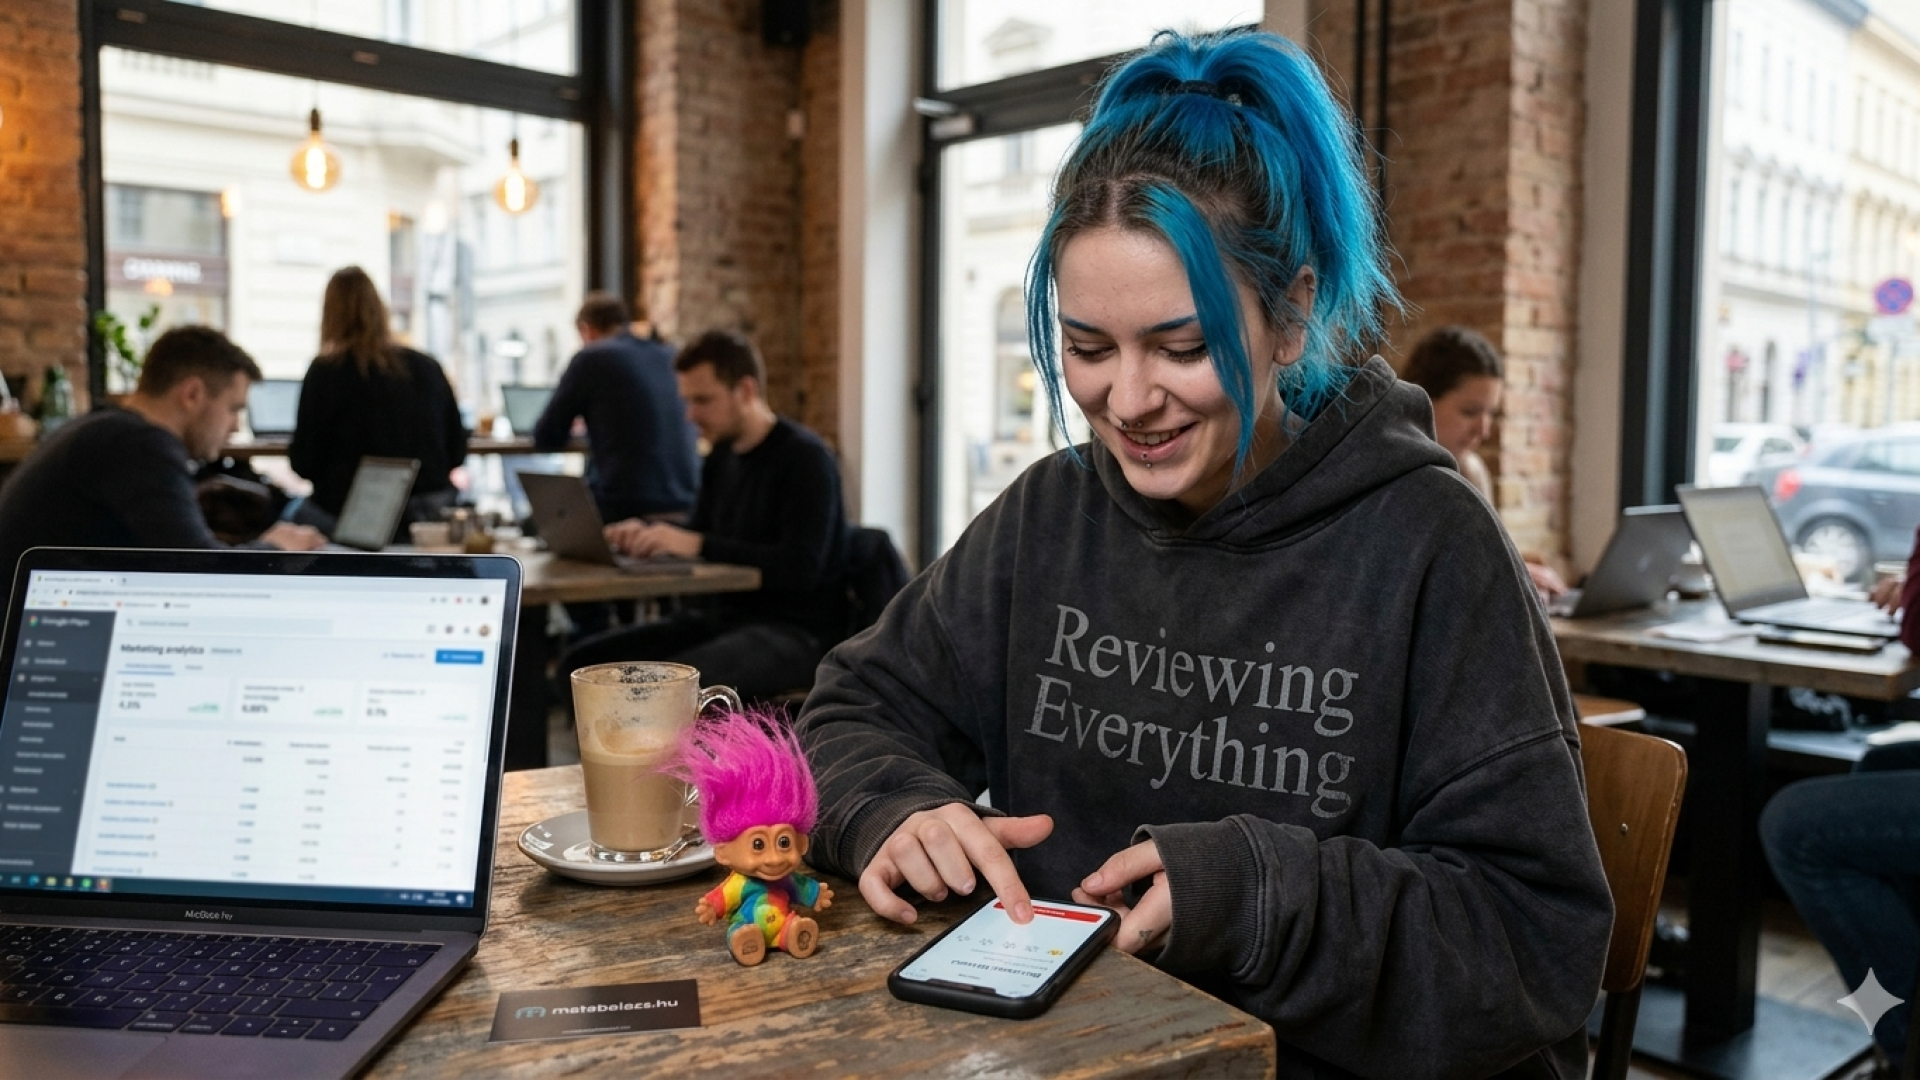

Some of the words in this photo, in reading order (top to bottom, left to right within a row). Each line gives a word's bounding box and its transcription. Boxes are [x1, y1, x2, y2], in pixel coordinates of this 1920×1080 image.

[120, 644, 164, 655] Marketing
[1045, 604, 1359, 737] Reviewing
[1024, 674, 1355, 818] Everything
